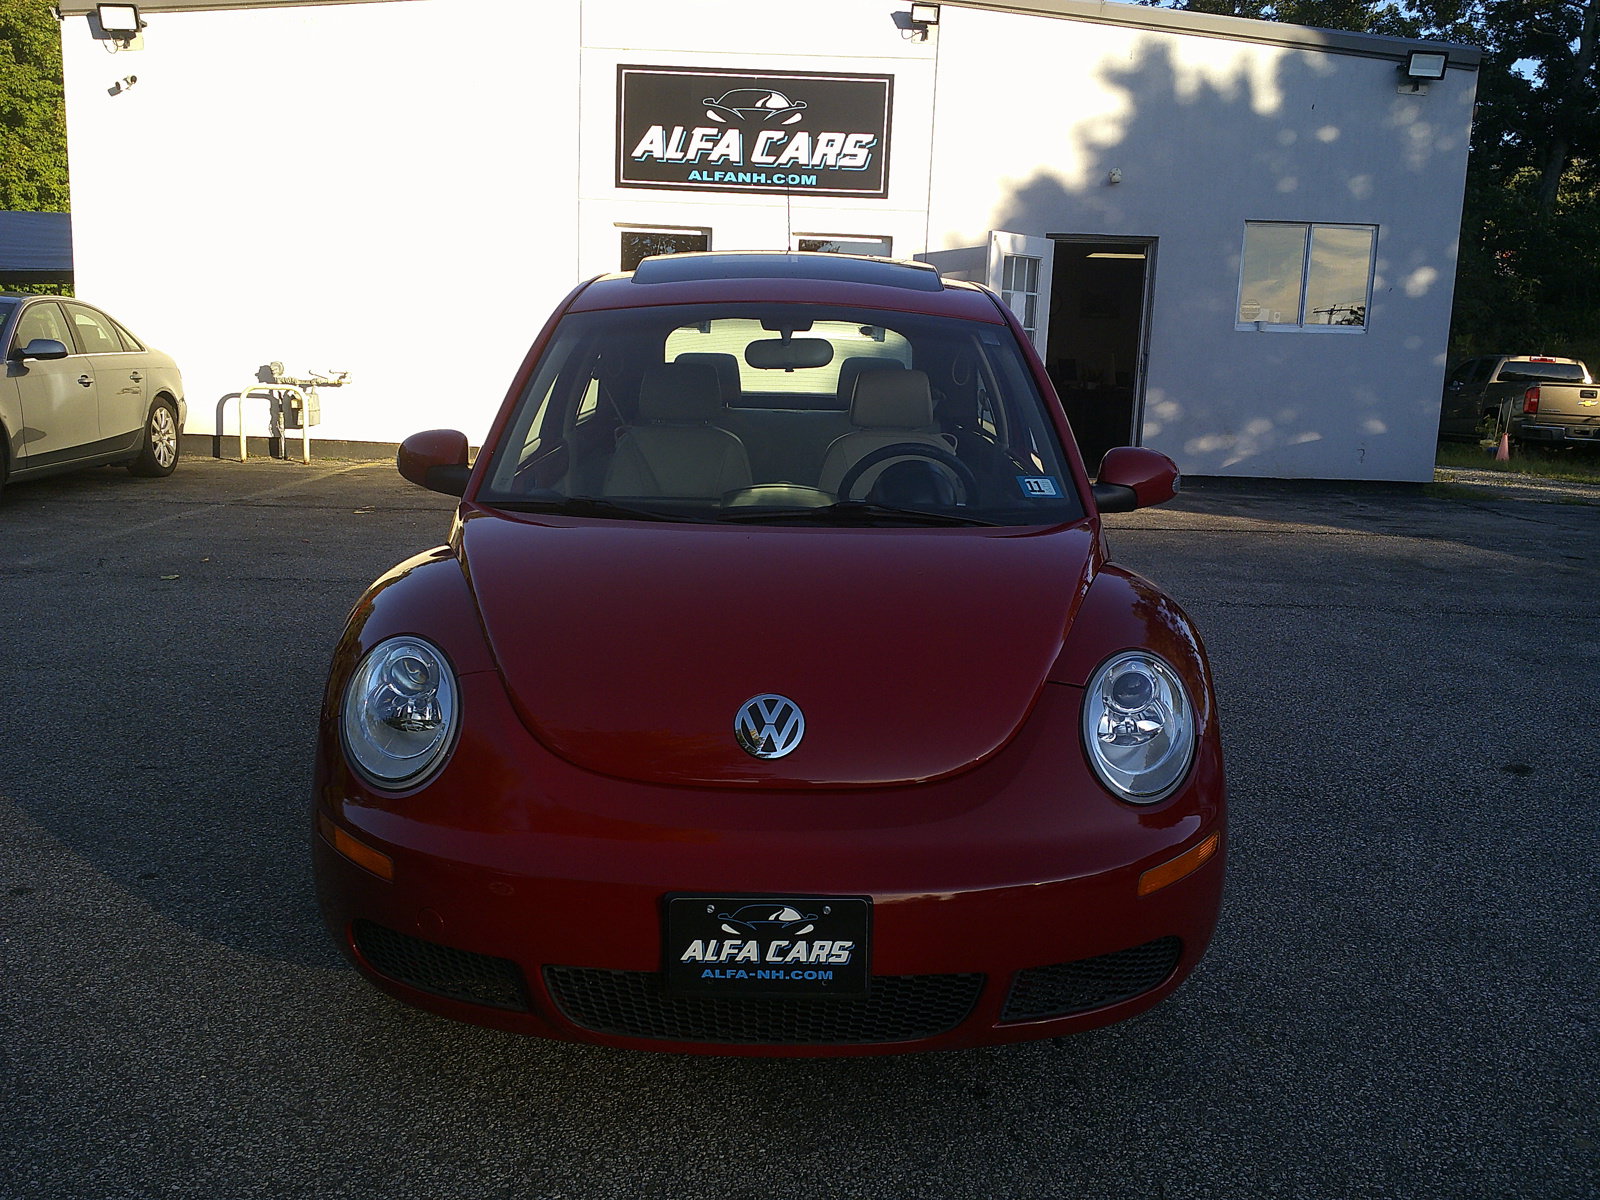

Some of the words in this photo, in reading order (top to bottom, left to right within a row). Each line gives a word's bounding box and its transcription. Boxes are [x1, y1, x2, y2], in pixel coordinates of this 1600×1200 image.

[631, 125, 743, 165] ALFA
[751, 130, 877, 170] CARS
[688, 170, 817, 186] ALFANH.COM
[1026, 481, 1046, 493] 11
[735, 694, 804, 758] VW
[680, 939, 760, 964] ALFA
[765, 940, 855, 966] CARS
[701, 969, 833, 980] ALFA-NH.COM
